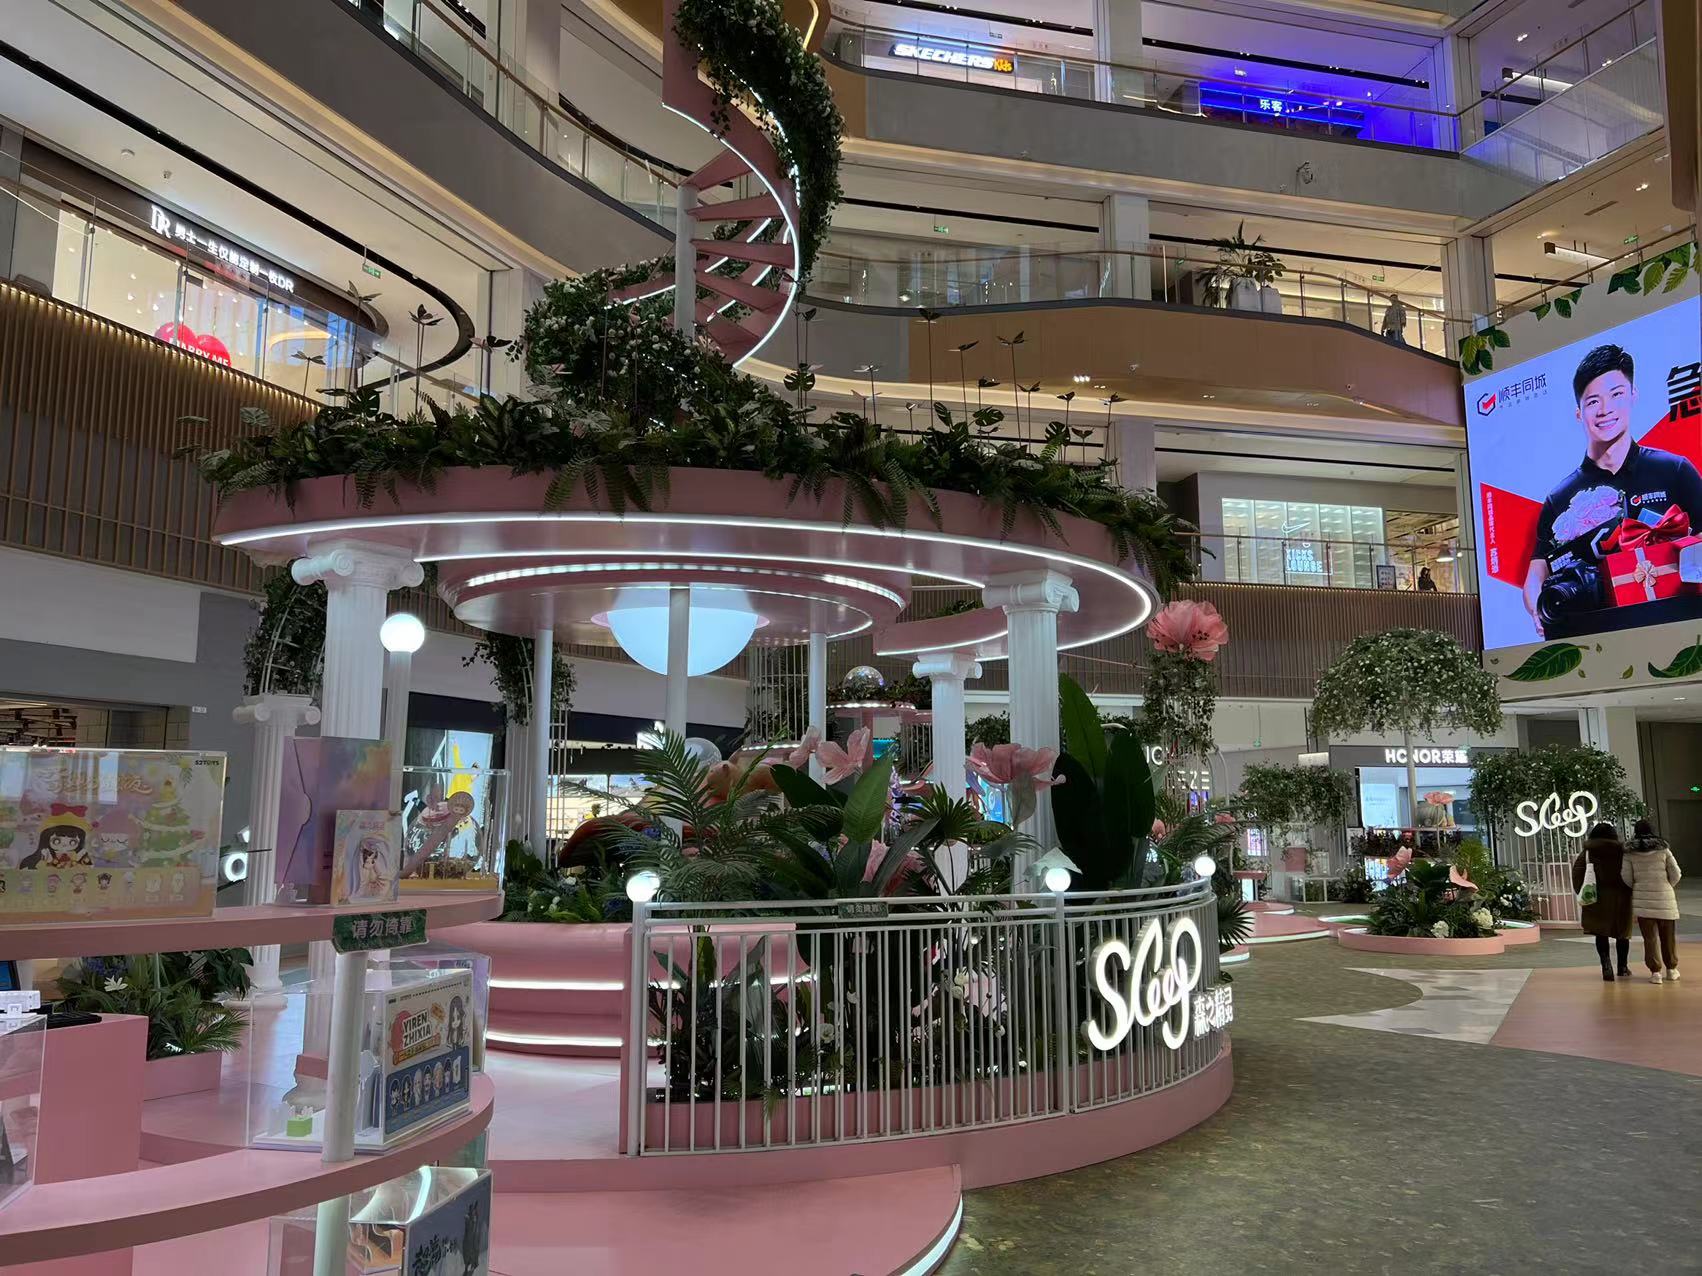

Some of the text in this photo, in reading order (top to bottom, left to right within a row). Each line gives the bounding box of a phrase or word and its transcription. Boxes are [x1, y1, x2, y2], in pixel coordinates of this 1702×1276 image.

[893, 43, 995, 69] SKECHERS
[1498, 373, 1548, 404] 顺丰同城
[352, 915, 414, 940] 请勿倚靠
[402, 1011, 428, 1034] YIREN
[403, 1023, 432, 1048] ZHIXIA
